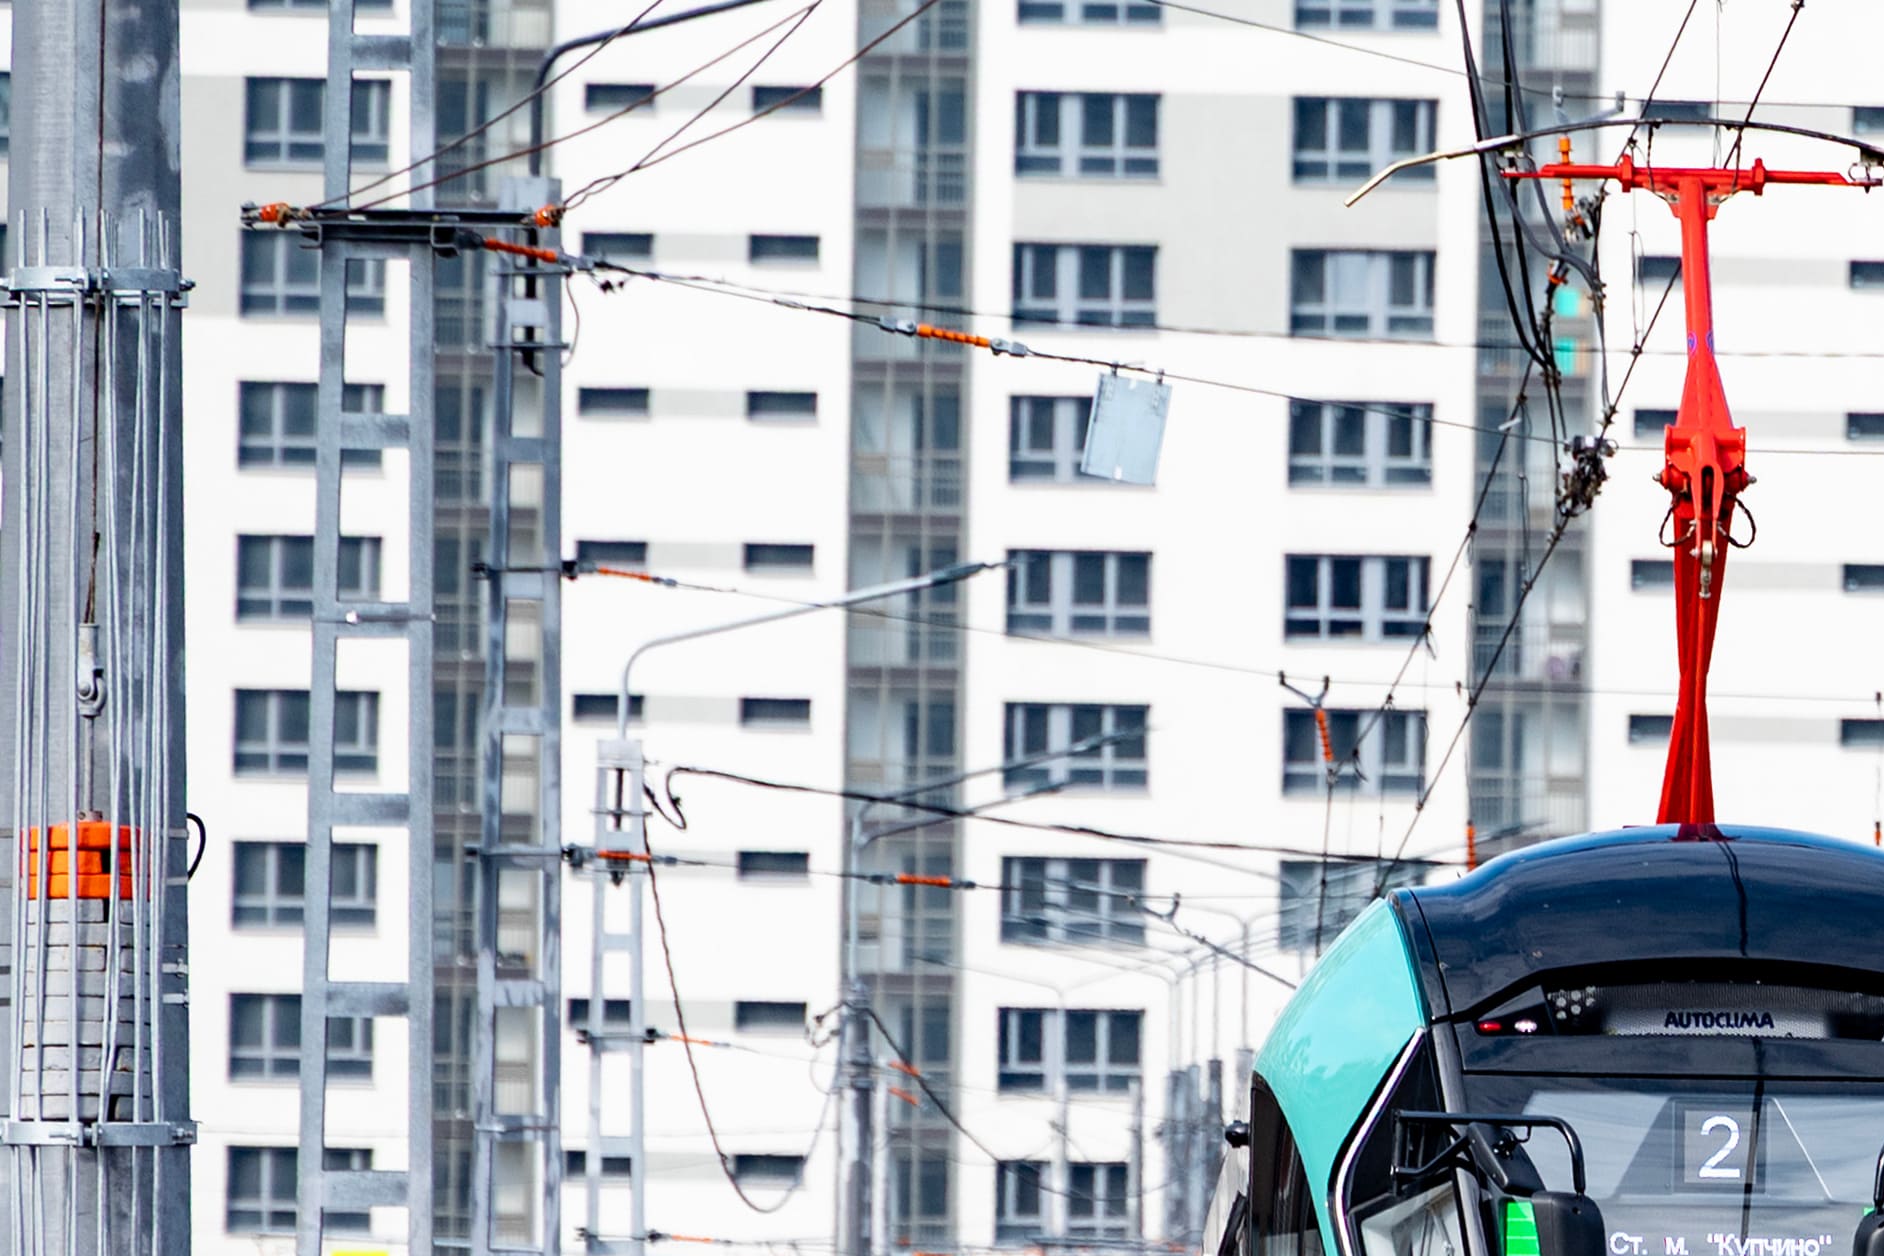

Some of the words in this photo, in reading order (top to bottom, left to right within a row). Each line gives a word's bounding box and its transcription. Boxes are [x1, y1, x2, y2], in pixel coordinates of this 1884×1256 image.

[1664, 1011, 1774, 1029] AUTOCLIMA
[1699, 1116, 1740, 1178] 2
[1610, 1232, 1648, 1256] Ст.
